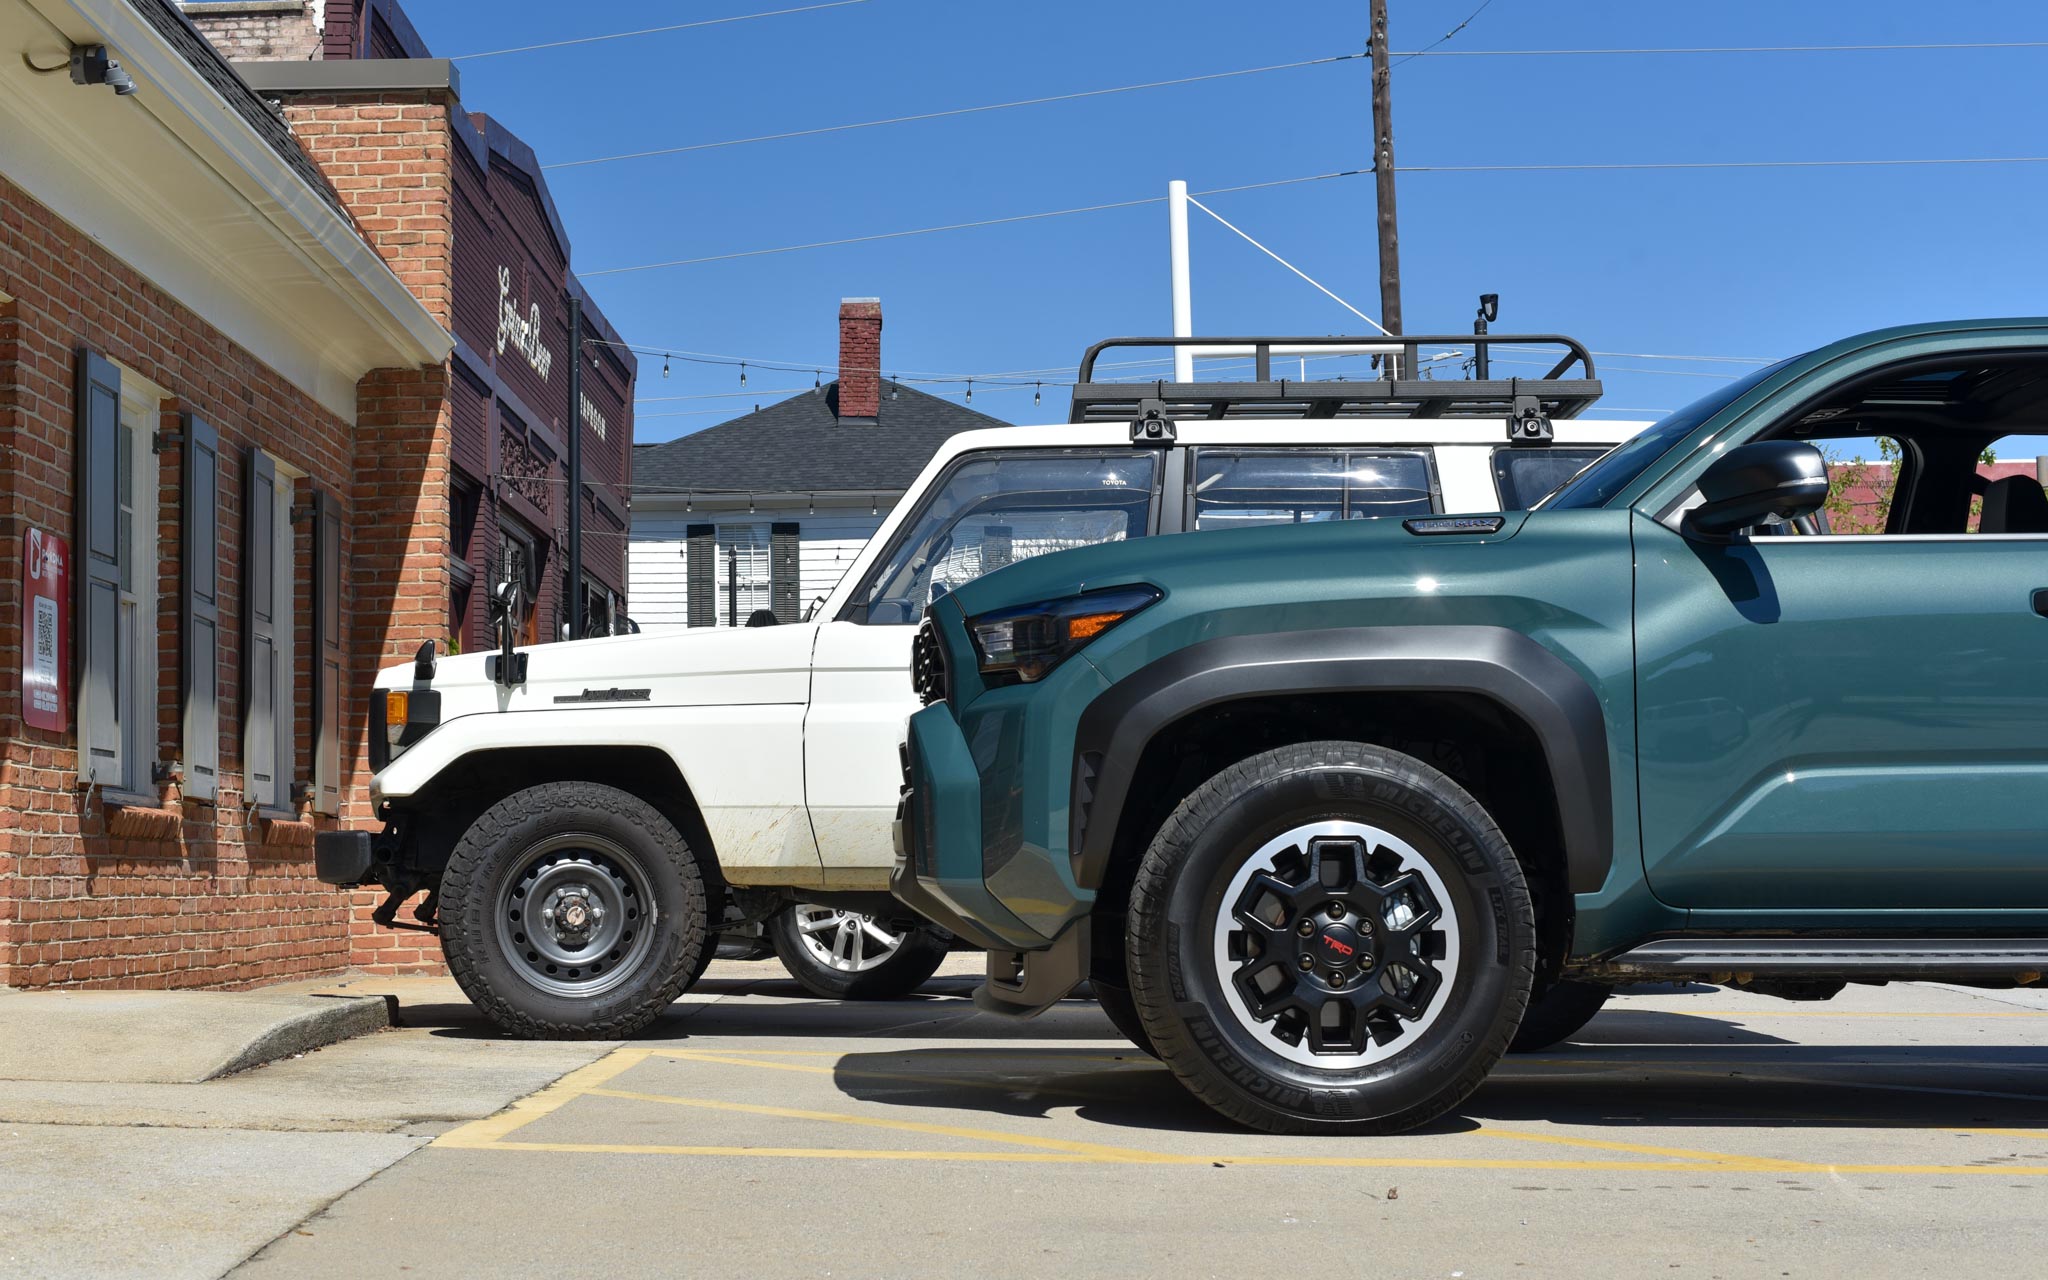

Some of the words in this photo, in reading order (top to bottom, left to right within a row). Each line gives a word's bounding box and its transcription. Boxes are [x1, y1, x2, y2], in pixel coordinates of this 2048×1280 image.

[1372, 779, 1482, 871] MICHELIN
[1323, 935, 1353, 956] TRD
[1187, 1018, 1307, 1108] MICHELIN
